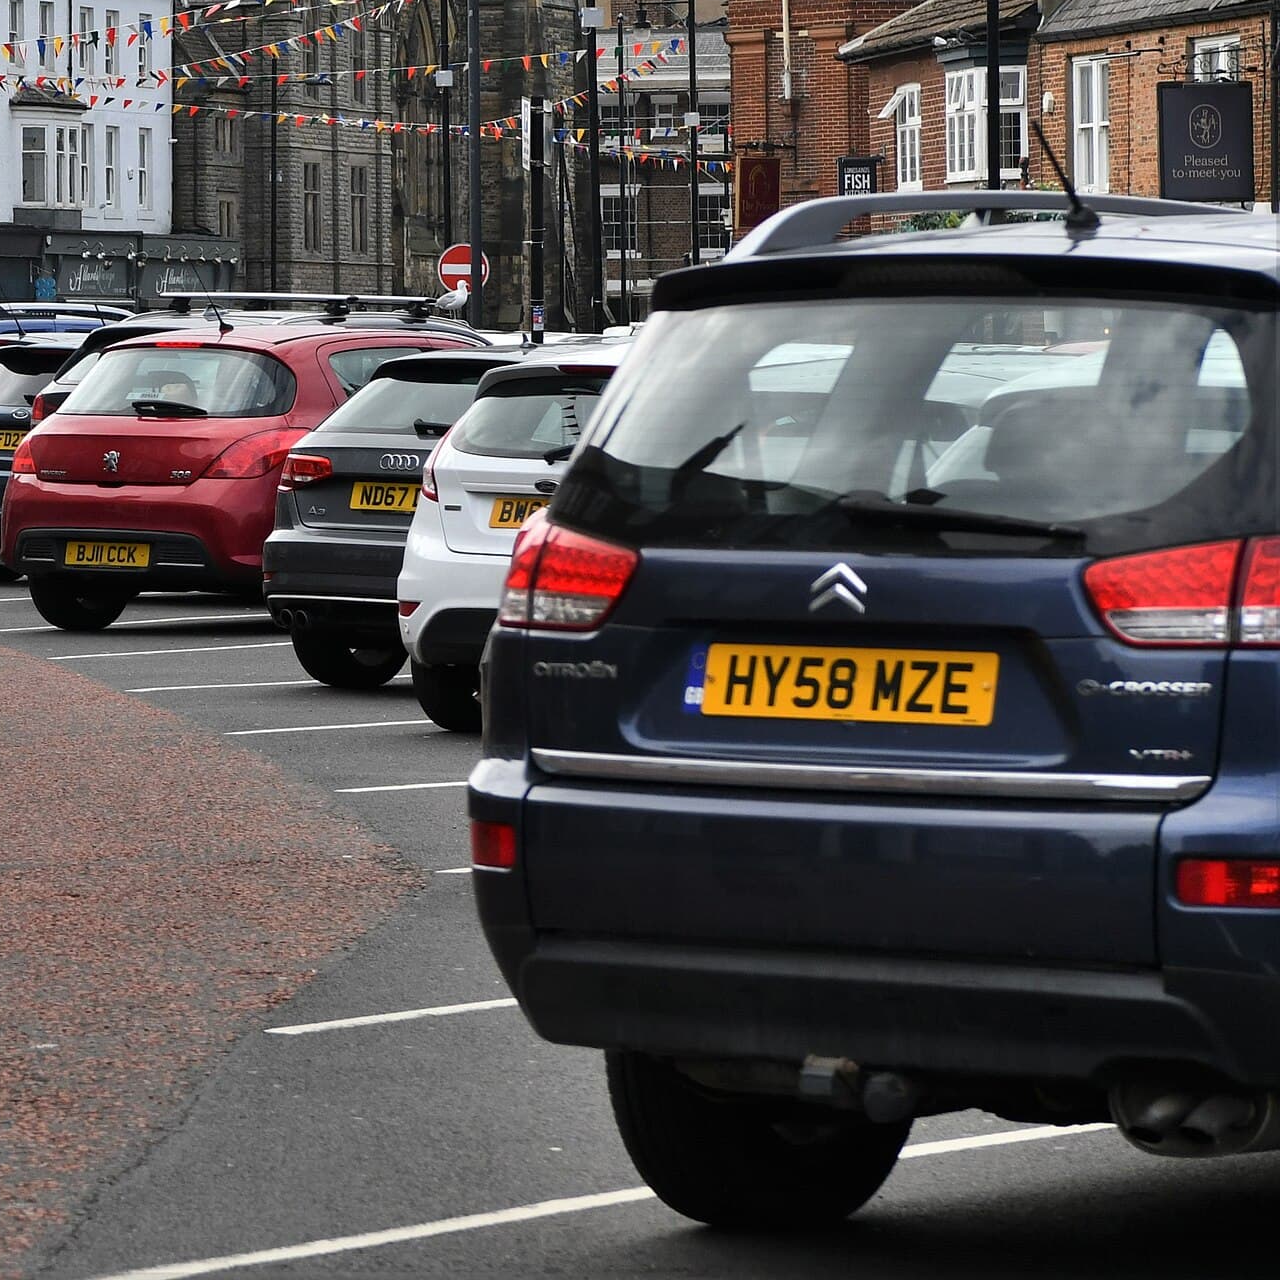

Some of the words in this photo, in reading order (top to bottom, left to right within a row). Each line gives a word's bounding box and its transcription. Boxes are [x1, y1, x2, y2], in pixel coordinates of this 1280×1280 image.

[1184, 154, 1228, 167] Pleased
[844, 174, 870, 189] FISH
[169, 470, 191, 478] 308
[359, 486, 408, 507] ND67
[76, 545, 103, 562] BJ11
[107, 546, 138, 563] CCK
[725, 654, 858, 709] HY58
[871, 659, 975, 714] MZE
